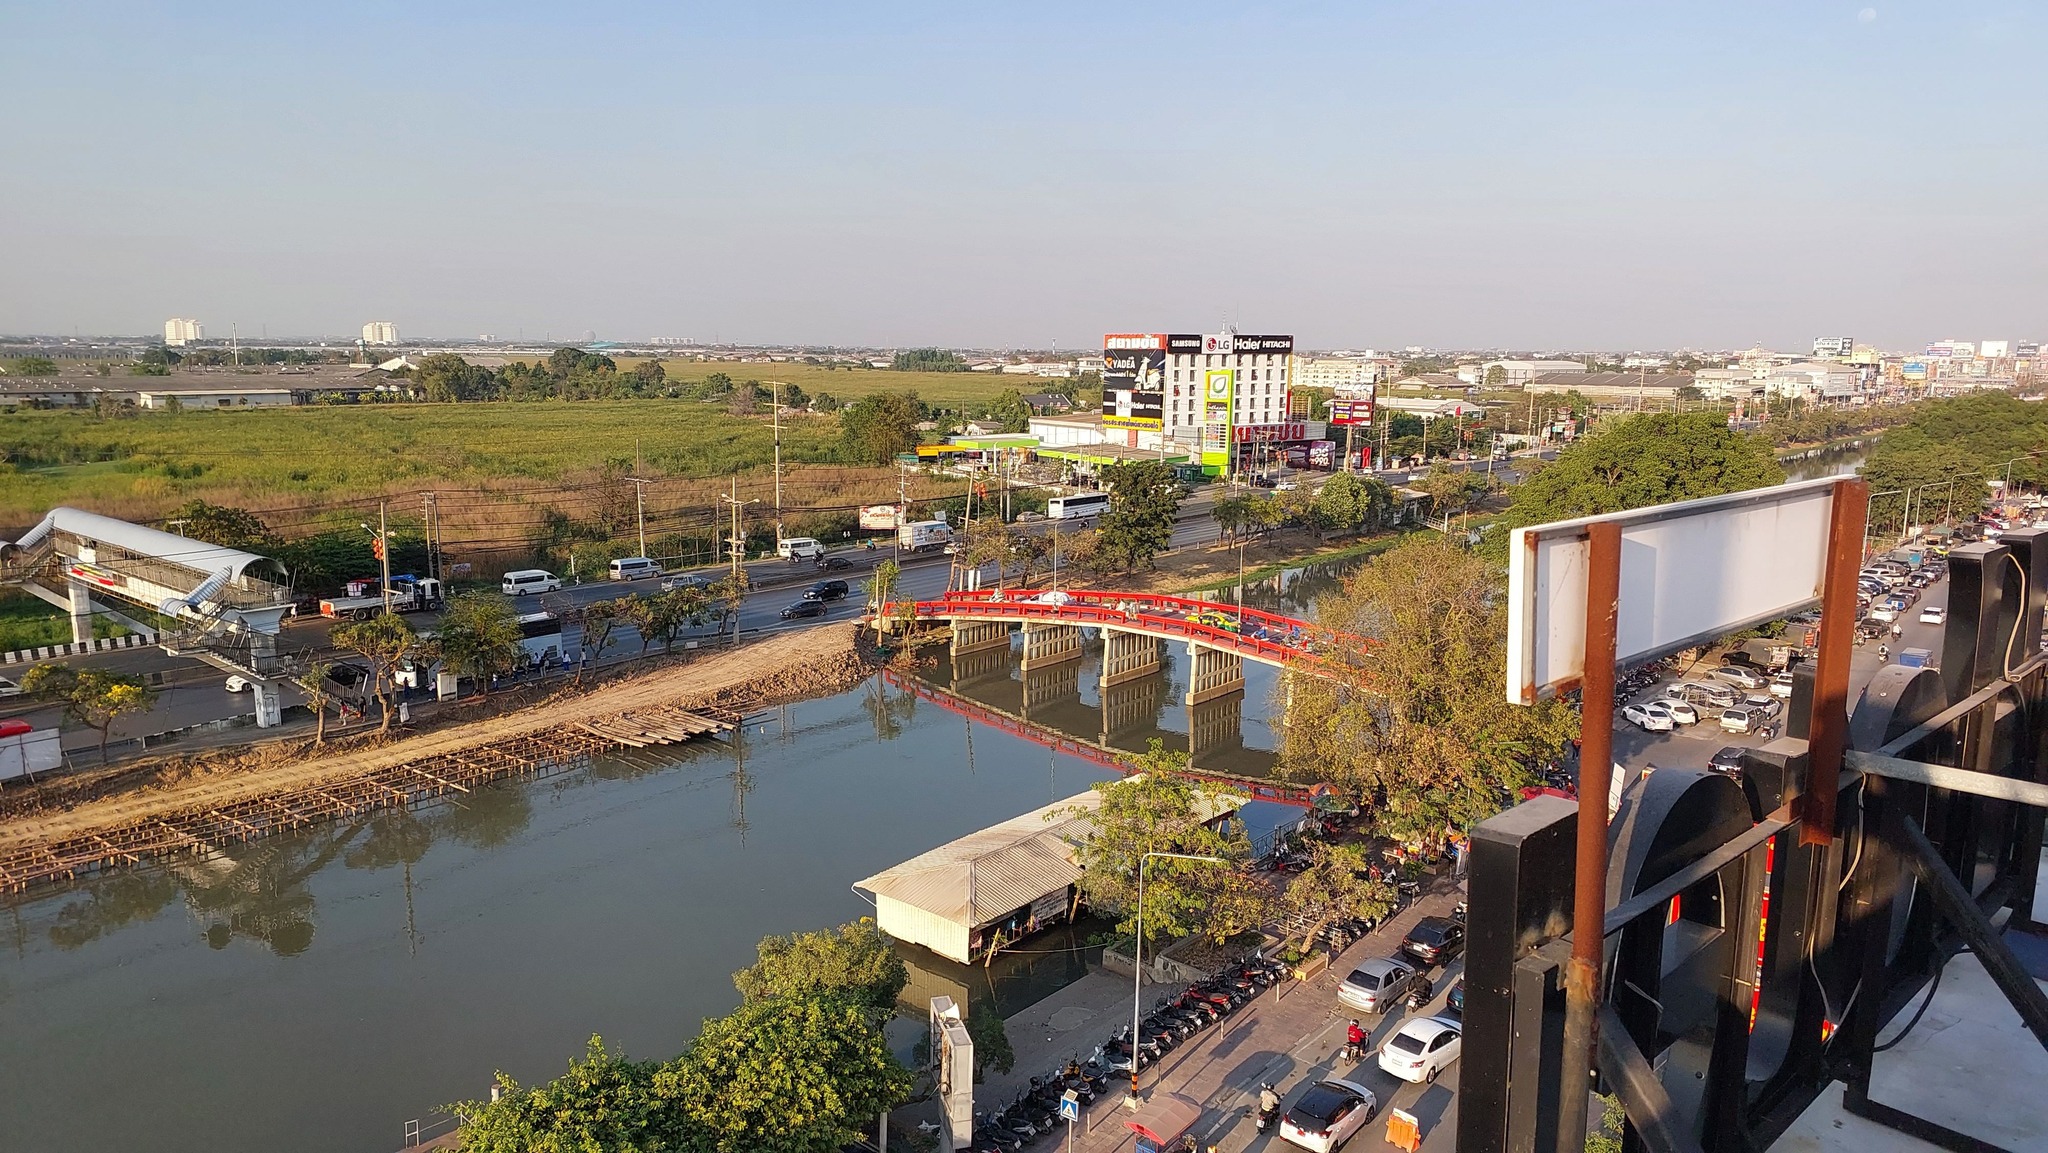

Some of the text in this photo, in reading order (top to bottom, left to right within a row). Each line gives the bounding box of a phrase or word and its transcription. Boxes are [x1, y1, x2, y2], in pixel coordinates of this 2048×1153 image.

[1171, 339, 1201, 348] SAMSUNG
[1218, 340, 1230, 350] LG
[1234, 338, 1261, 350] Haier
[1112, 359, 1136, 369] YADEA
